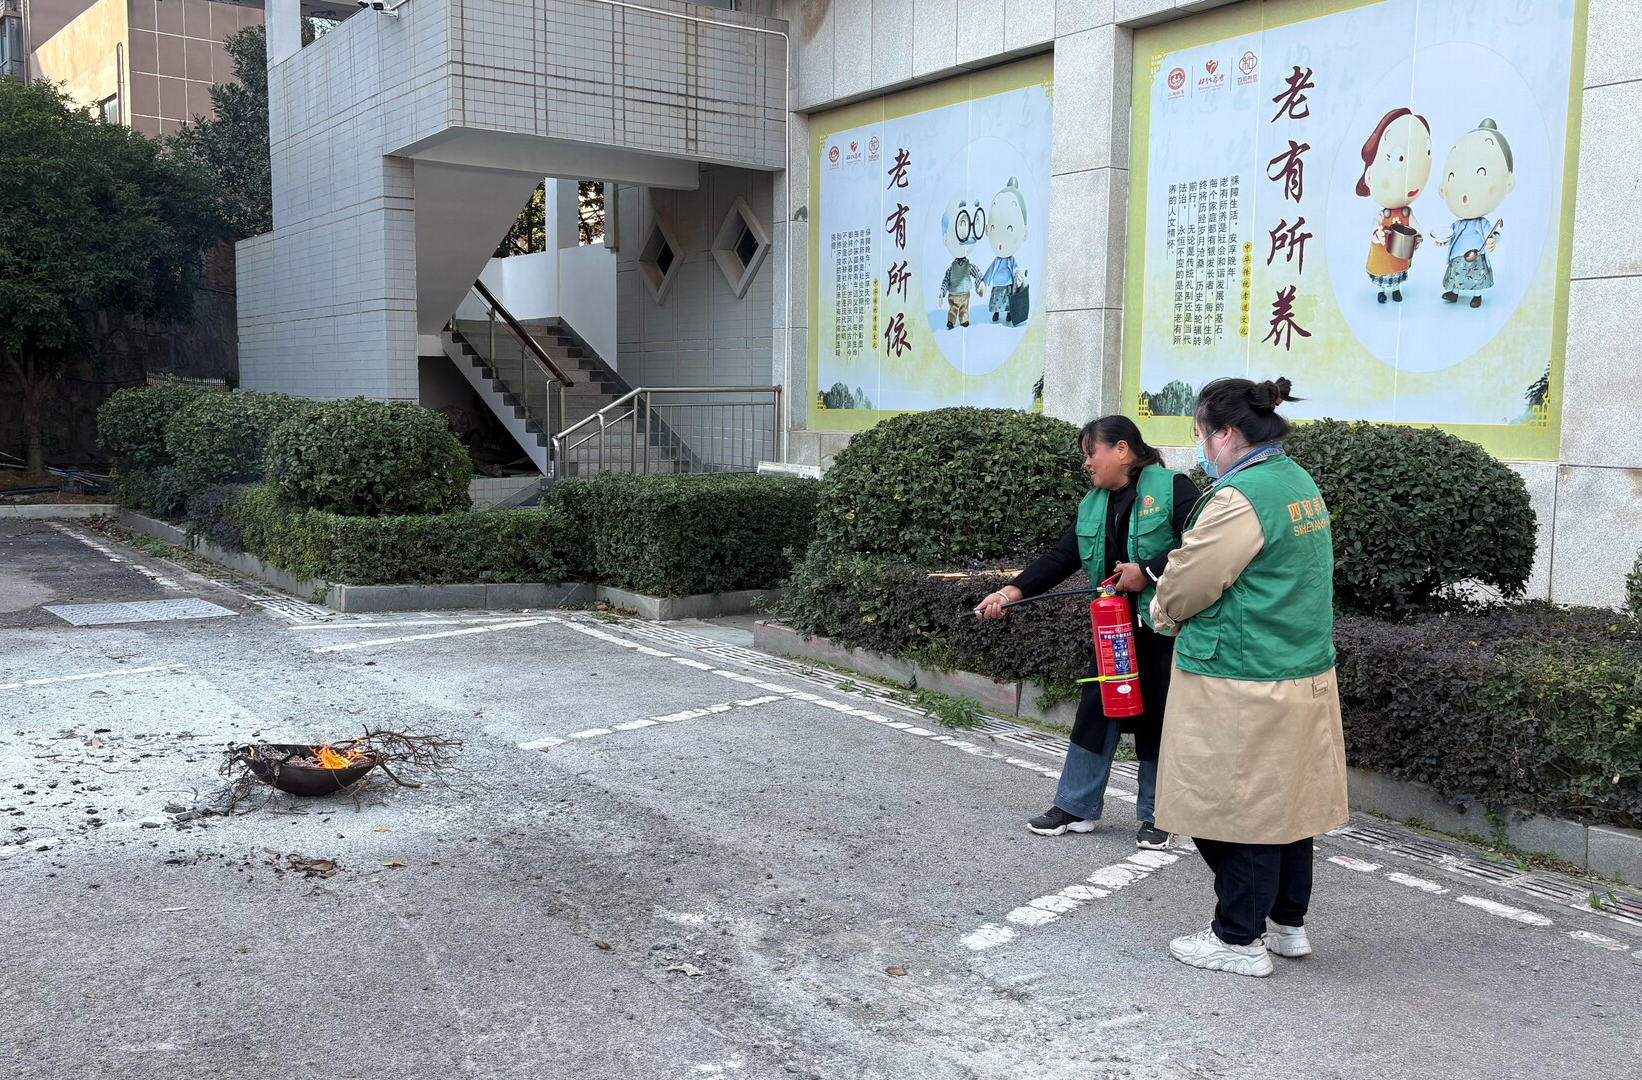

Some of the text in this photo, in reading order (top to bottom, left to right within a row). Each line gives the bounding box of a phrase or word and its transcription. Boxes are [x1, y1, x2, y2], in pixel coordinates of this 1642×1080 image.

[885, 147, 912, 358] 老有所依
[1261, 65, 1313, 351] 老有所养
